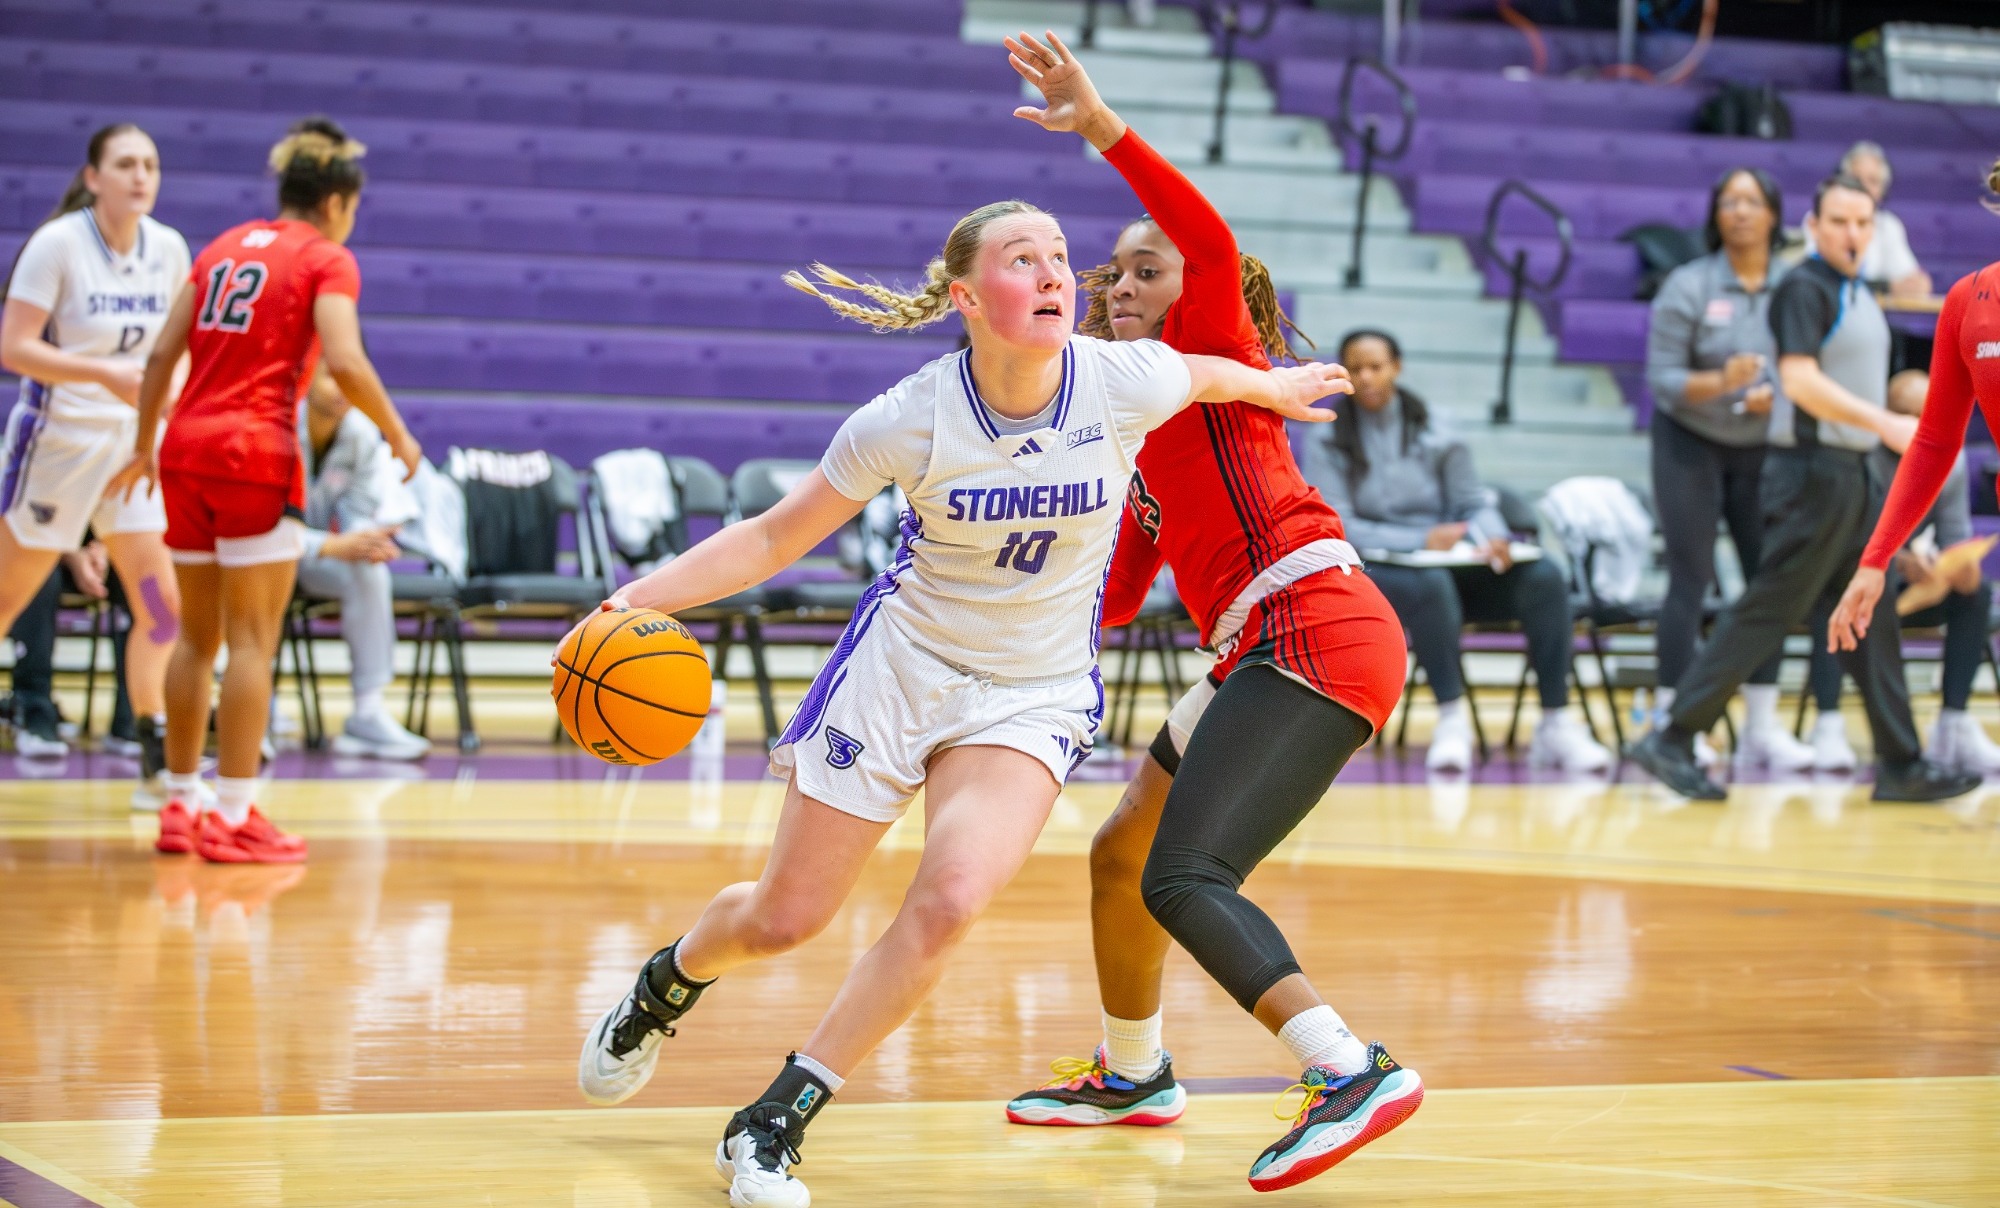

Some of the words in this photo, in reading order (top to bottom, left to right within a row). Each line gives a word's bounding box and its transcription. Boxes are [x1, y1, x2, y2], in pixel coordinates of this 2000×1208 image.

[197, 258, 268, 334] 12
[1066, 422, 1102, 447] NEC
[946, 477, 1109, 523] STONEHILL
[993, 530, 1058, 575] 10
